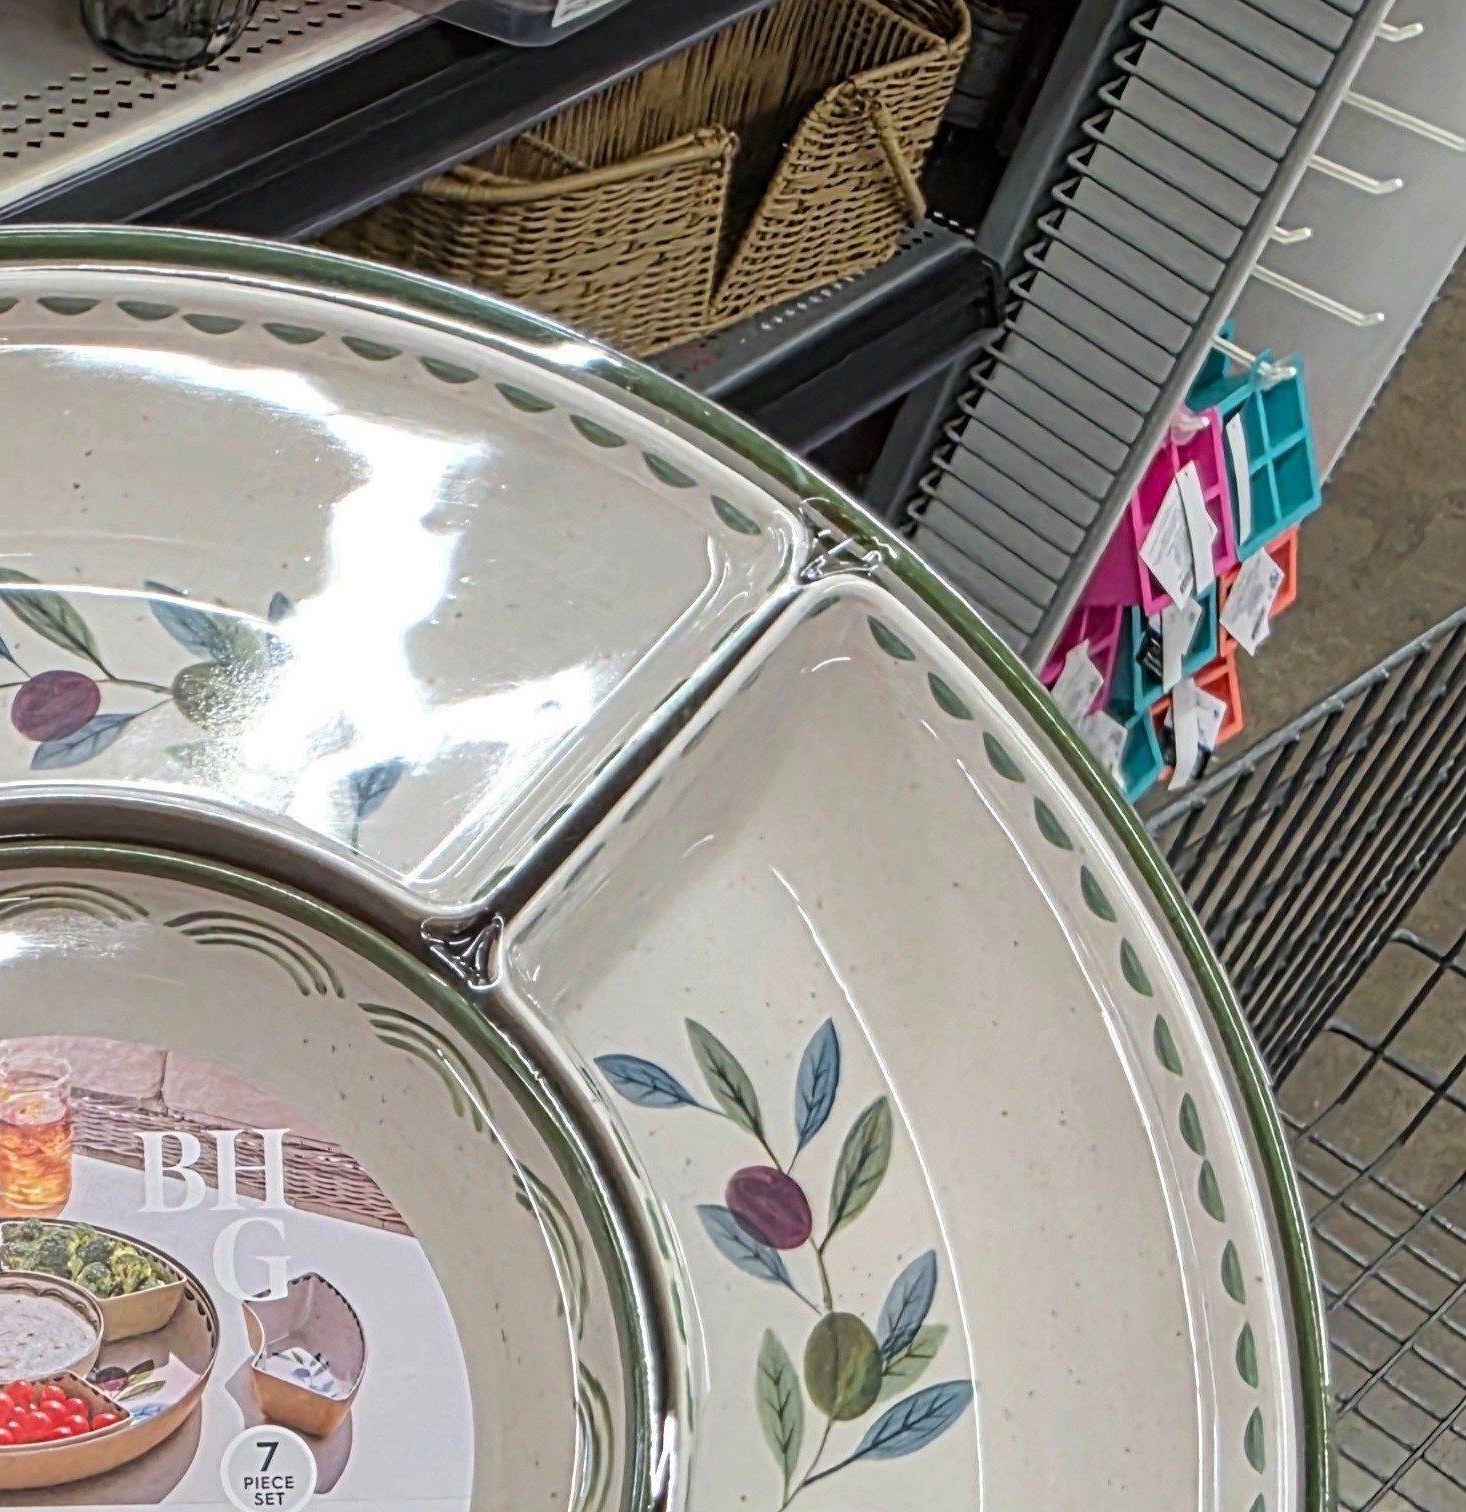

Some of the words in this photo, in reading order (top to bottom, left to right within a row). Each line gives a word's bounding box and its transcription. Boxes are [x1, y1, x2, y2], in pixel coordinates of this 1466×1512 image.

[134, 1128, 291, 1213] BH
[212, 1216, 292, 1302] G
[256, 1441, 280, 1472] 7
[243, 1476, 294, 1490] PIECE
[254, 1492, 285, 1506] SET
